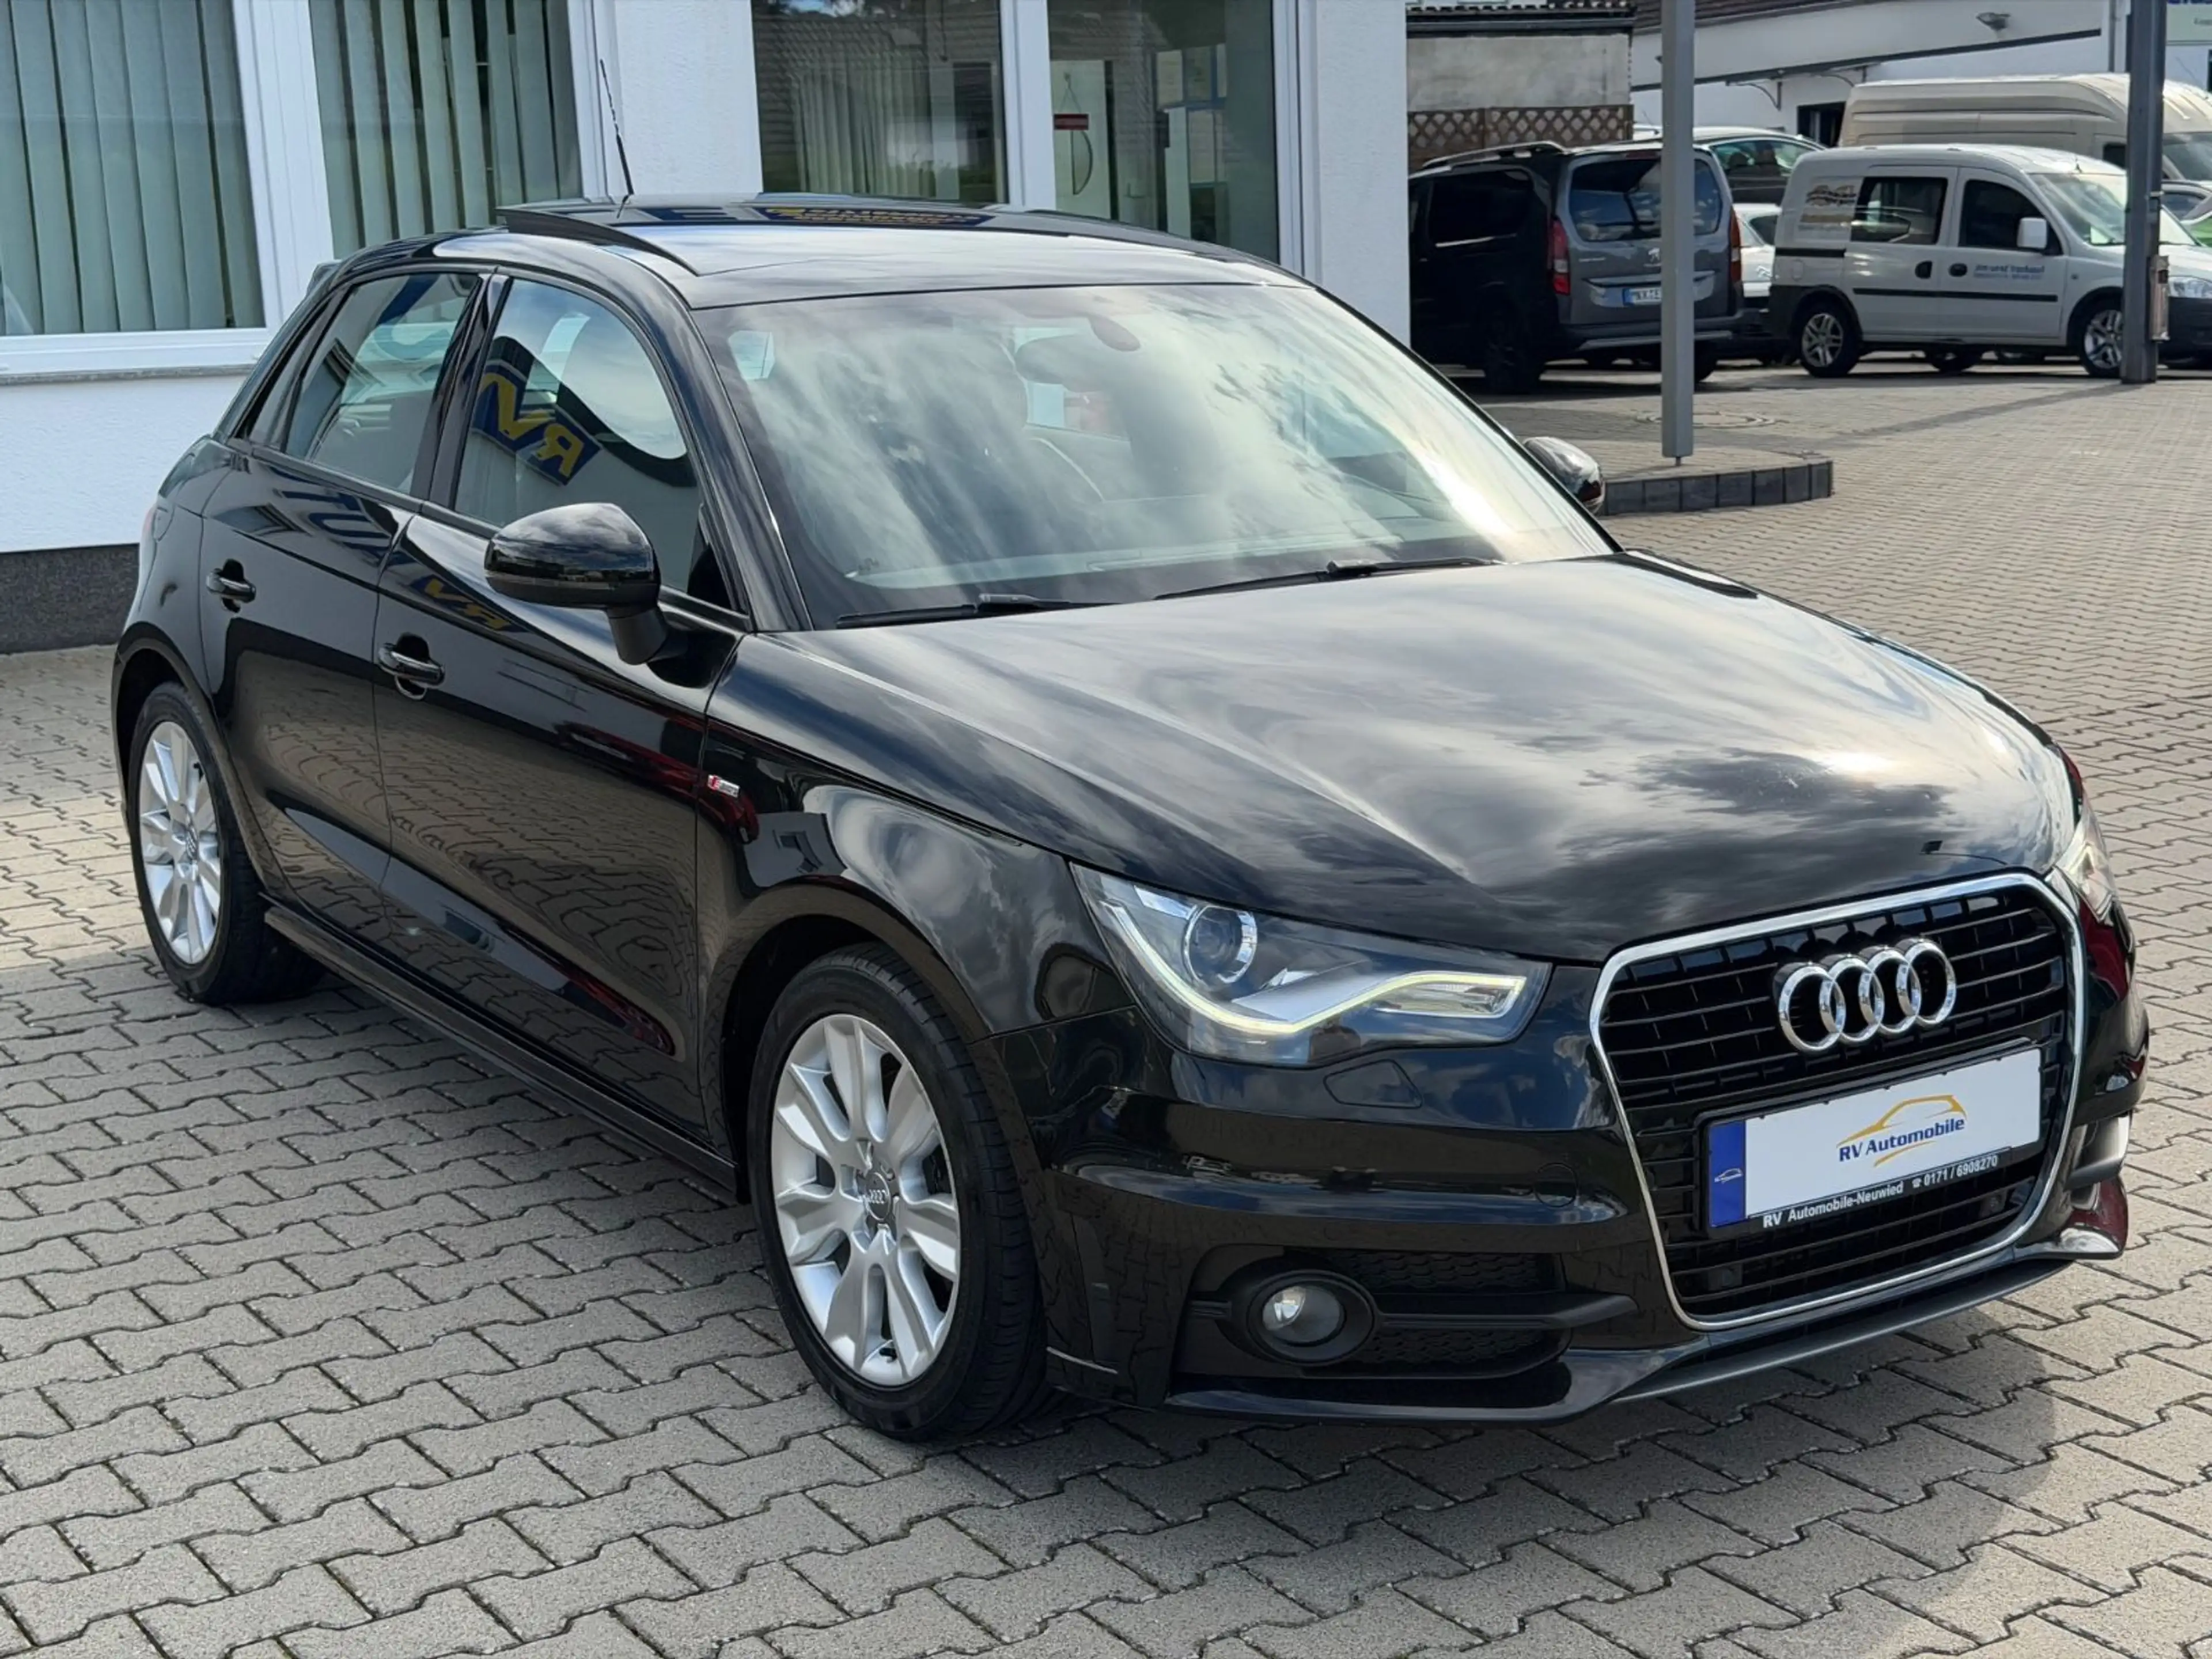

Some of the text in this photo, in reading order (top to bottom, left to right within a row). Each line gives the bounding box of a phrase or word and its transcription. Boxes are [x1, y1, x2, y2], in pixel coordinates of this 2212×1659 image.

[1839, 1118, 1964, 1162] RV Automobile
[1763, 1212, 1782, 1228] RV
[1787, 1181, 1904, 1222] Automobile-Neuwied
[1924, 1169, 1948, 1186] 0171
